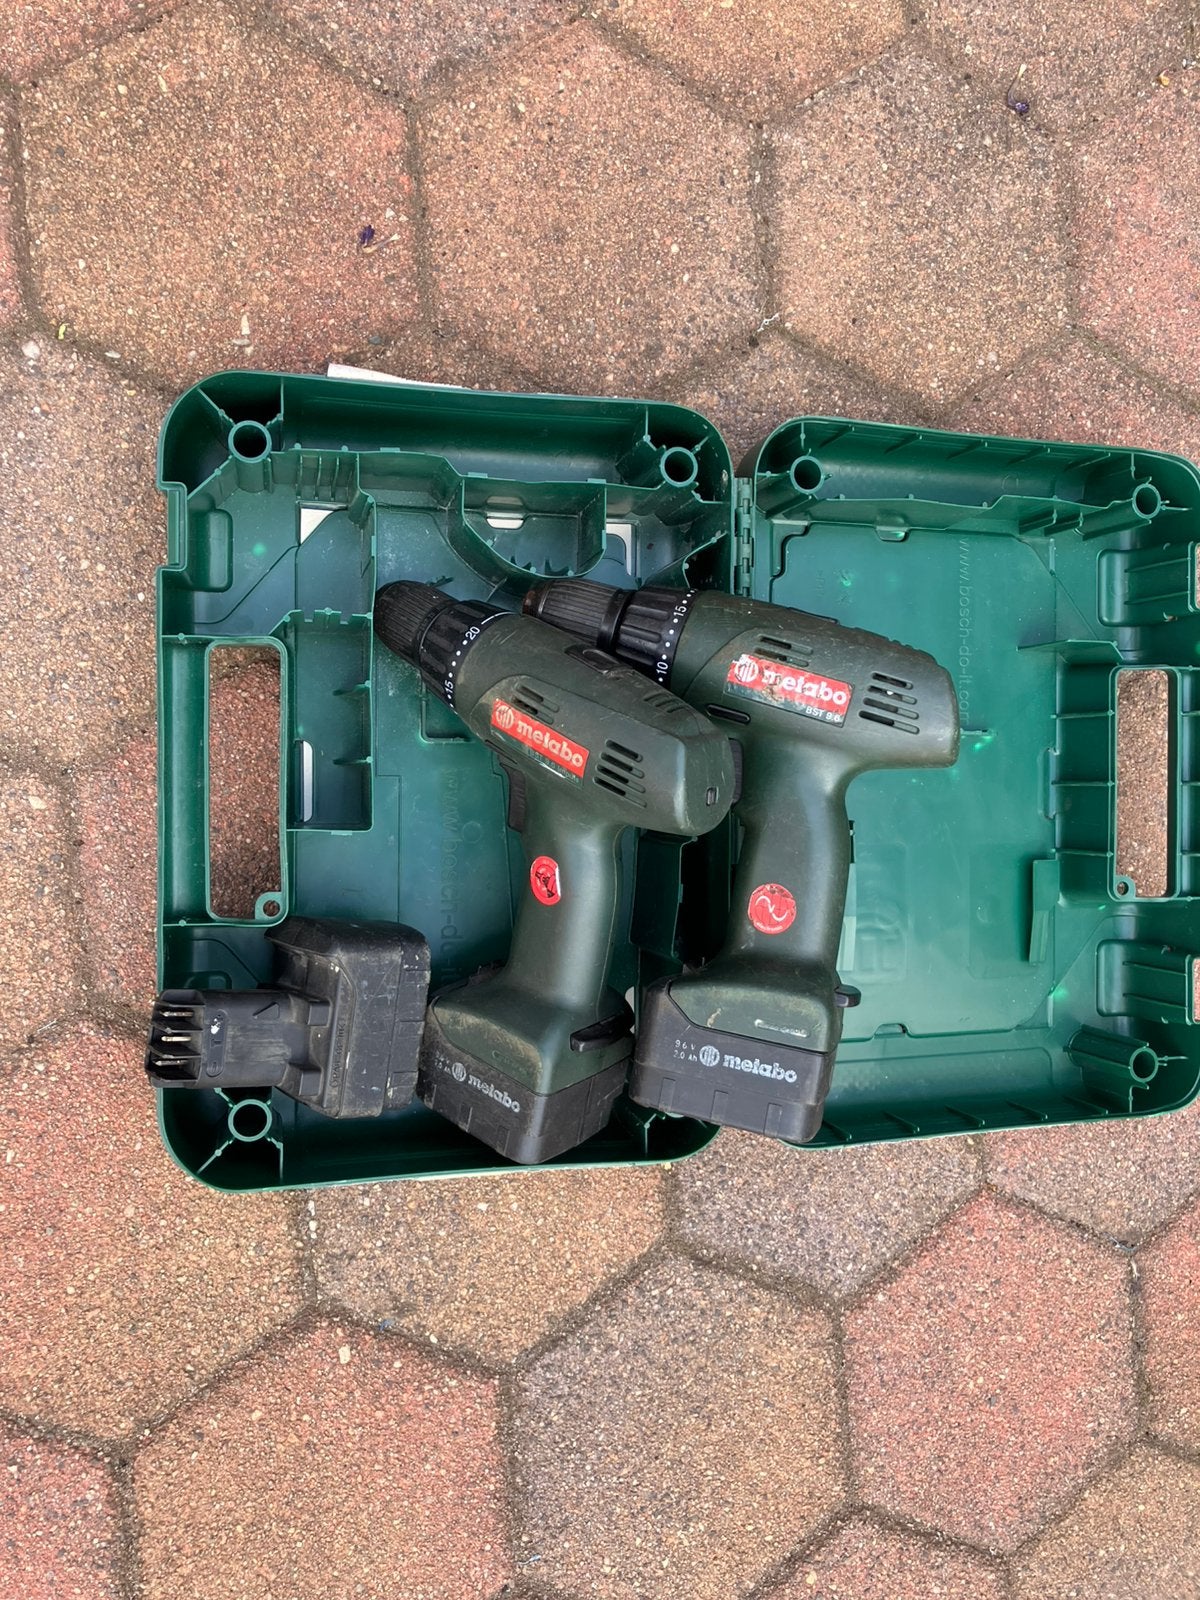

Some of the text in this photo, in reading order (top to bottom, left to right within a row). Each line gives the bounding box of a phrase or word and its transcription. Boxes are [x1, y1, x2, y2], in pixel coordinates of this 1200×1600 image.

[673, 604, 688, 618] 15
[465, 625, 481, 641] 20
[655, 661, 669, 675] 10
[443, 679, 454, 694] 15
[763, 668, 847, 705] metabo
[805, 705, 842, 722] BST 9.6
[516, 719, 584, 768] metabo
[722, 1053, 798, 1084] metabo
[468, 1073, 521, 1114] metabo
